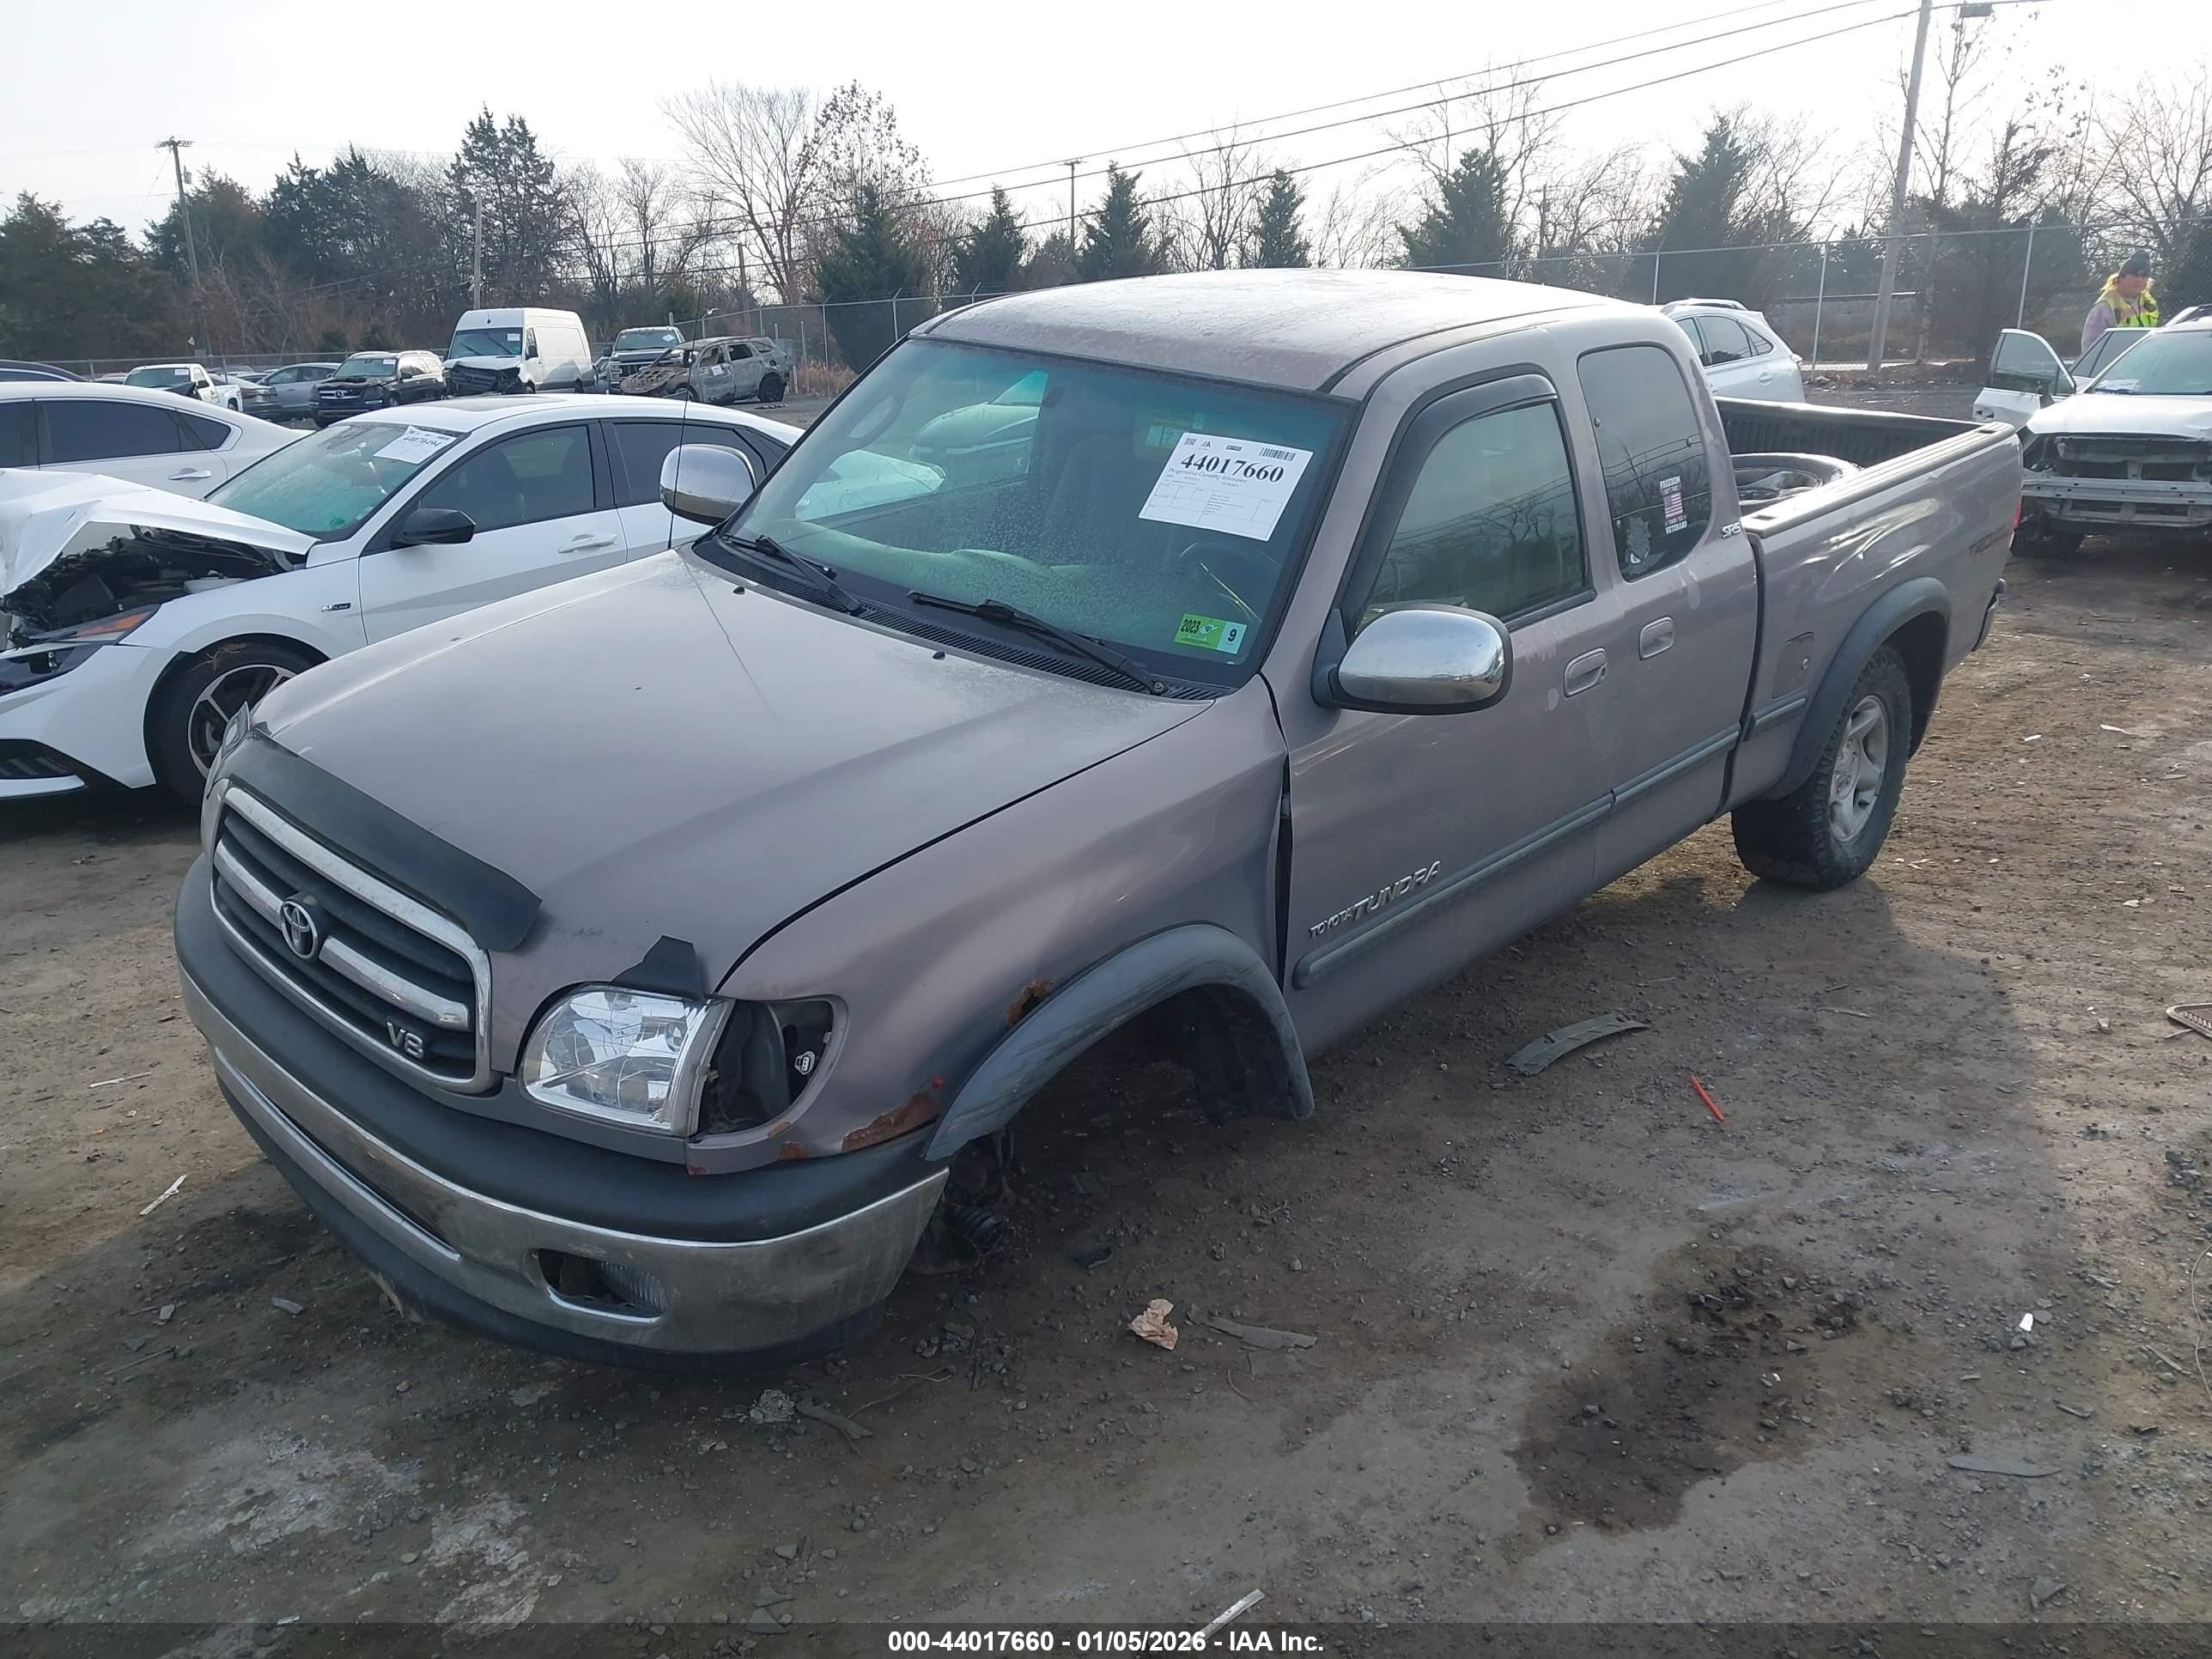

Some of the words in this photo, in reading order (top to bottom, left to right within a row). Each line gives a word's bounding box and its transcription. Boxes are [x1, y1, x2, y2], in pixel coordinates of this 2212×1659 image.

[1181, 453, 1285, 483] 44017660
[1181, 618, 1201, 634] 2023
[1227, 628, 1237, 642] 9
[1309, 906, 1354, 939] TOYOTA
[1352, 860, 1442, 921] TUNDRA
[386, 1021, 424, 1059] V8
